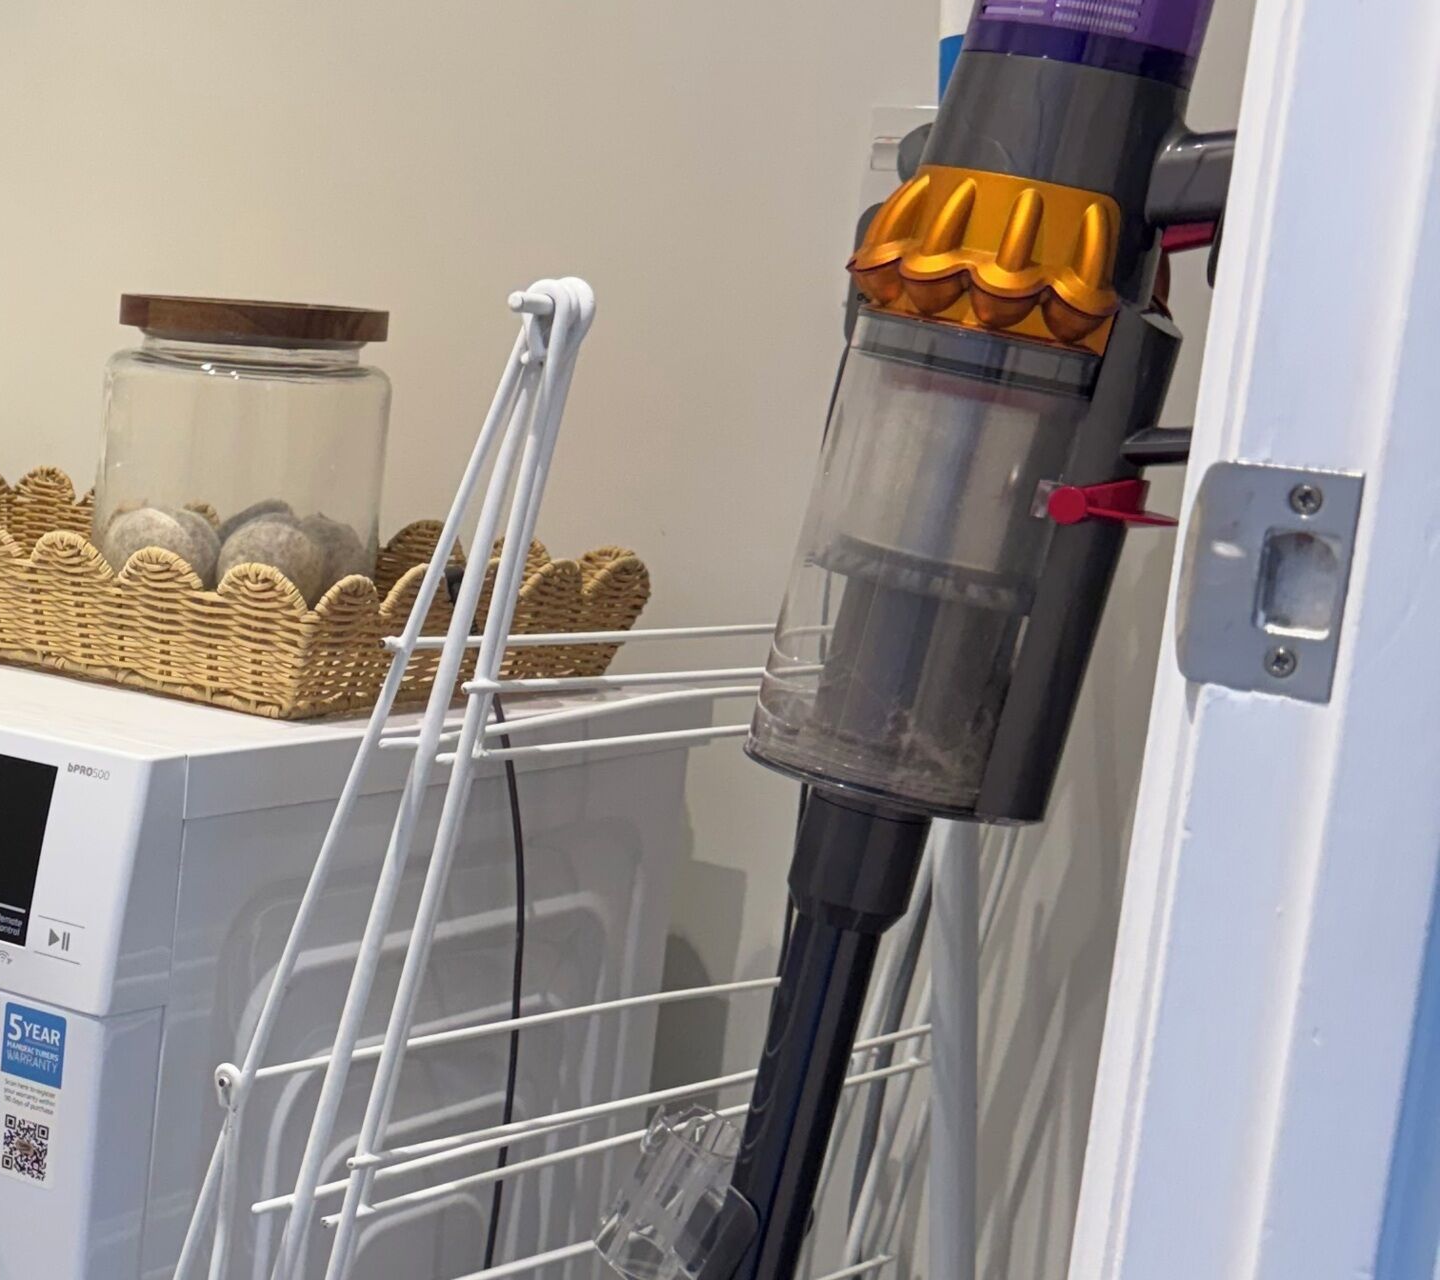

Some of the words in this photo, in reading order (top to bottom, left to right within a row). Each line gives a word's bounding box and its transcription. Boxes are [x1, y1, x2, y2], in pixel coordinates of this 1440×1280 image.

[67, 762, 110, 781] bPRO500
[7, 1013, 23, 1041] 5
[23, 1020, 61, 1047] YEAR
[6, 1049, 58, 1074] WARRANTY
